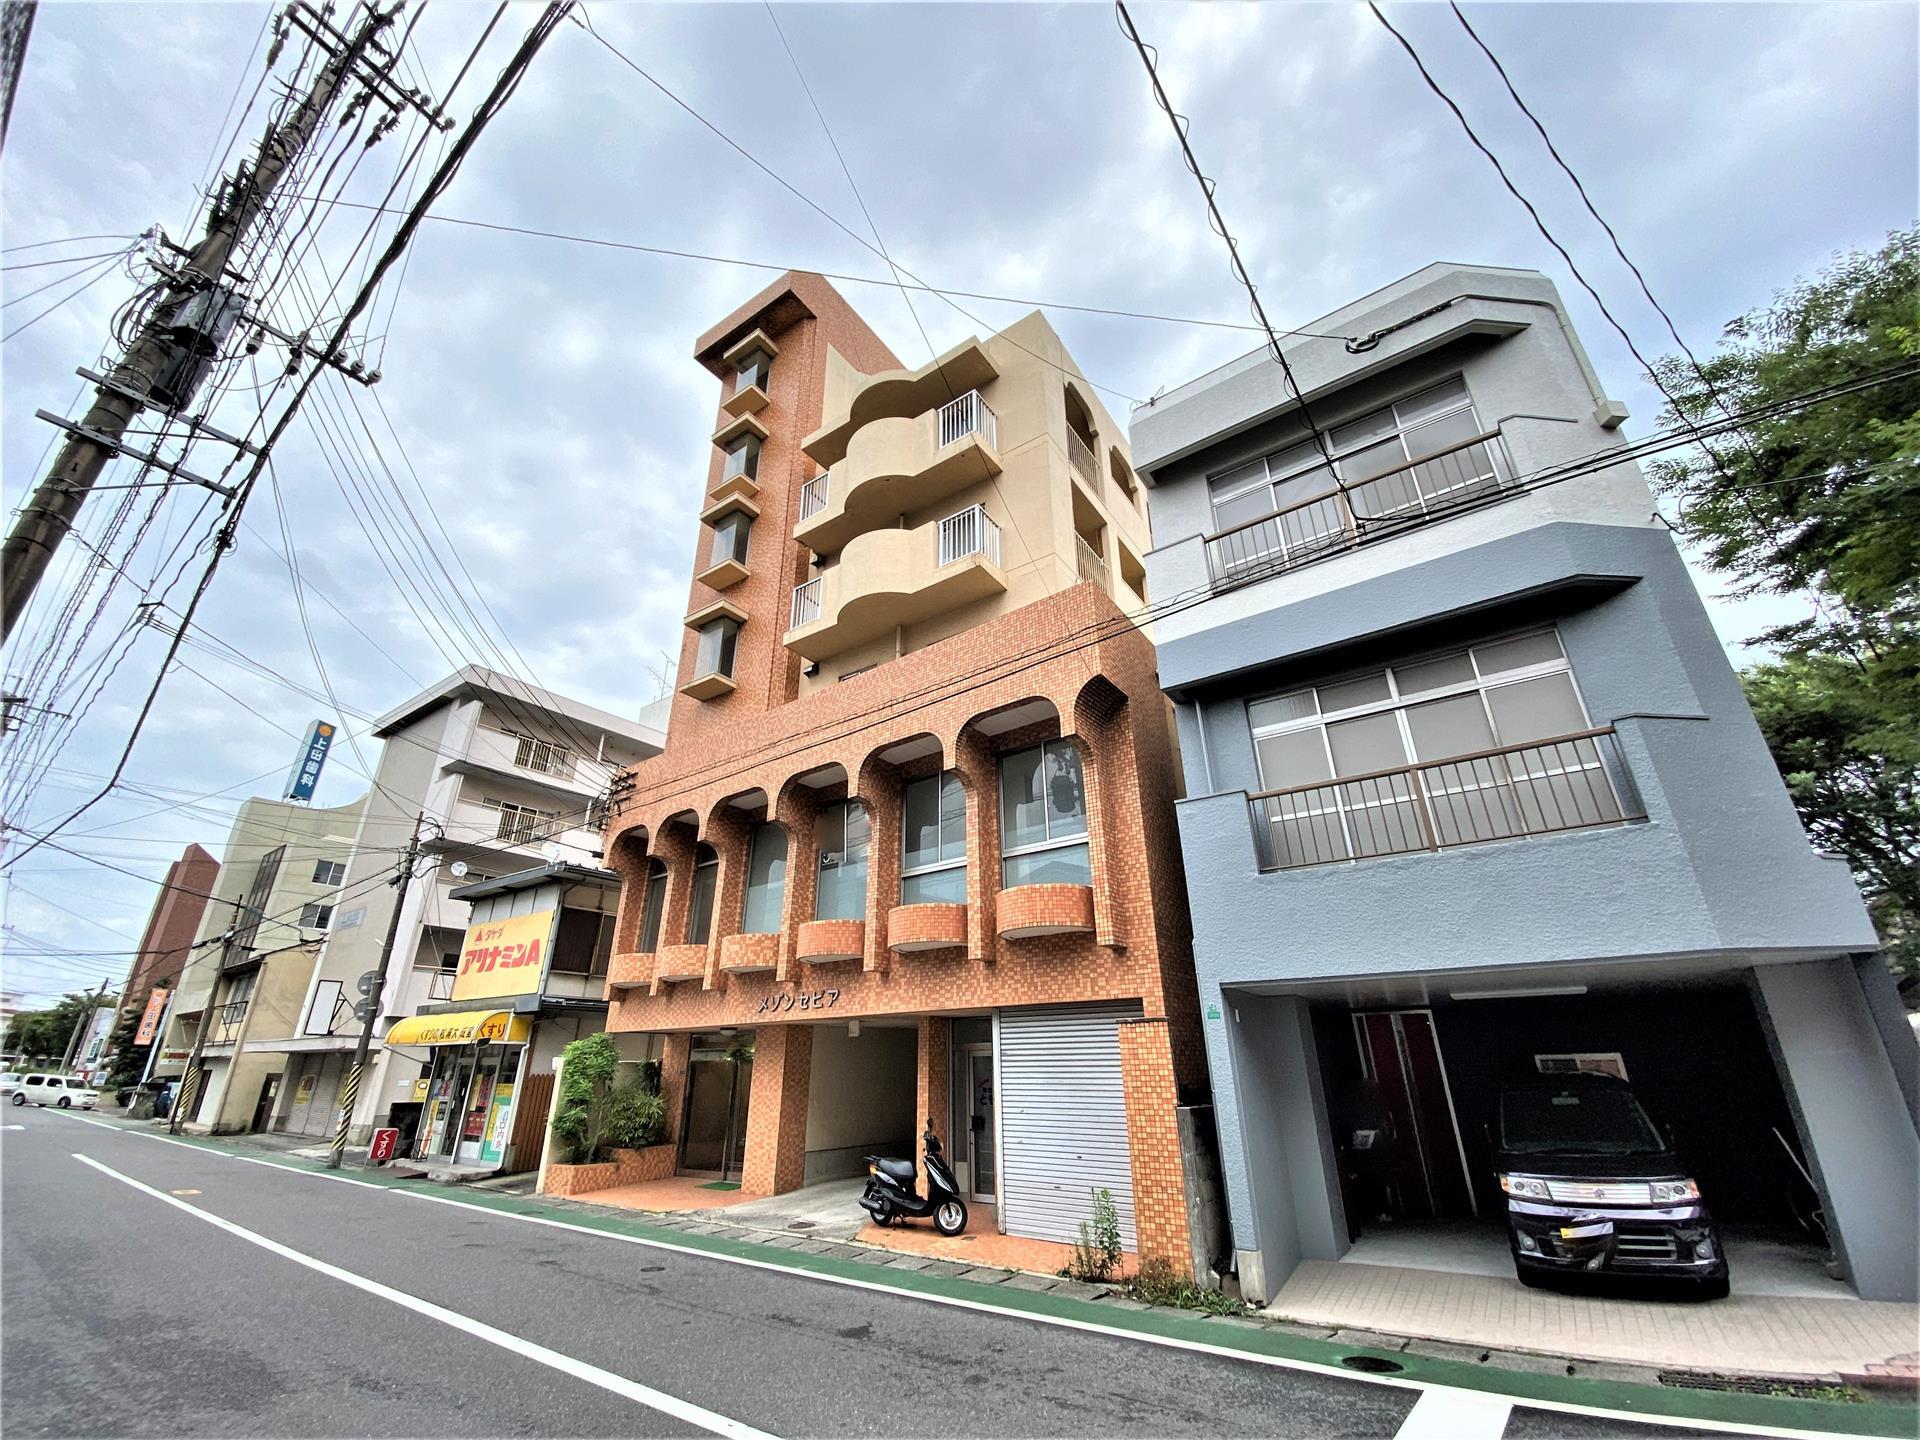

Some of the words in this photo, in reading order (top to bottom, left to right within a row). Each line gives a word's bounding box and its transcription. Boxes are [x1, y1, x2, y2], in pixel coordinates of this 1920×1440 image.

[300, 737, 327, 788] 上田歯科
[485, 925, 505, 941] タケダ
[460, 938, 541, 976] アリナミンA
[480, 1023, 506, 1038] くすり
[377, 1131, 391, 1157] くすり
